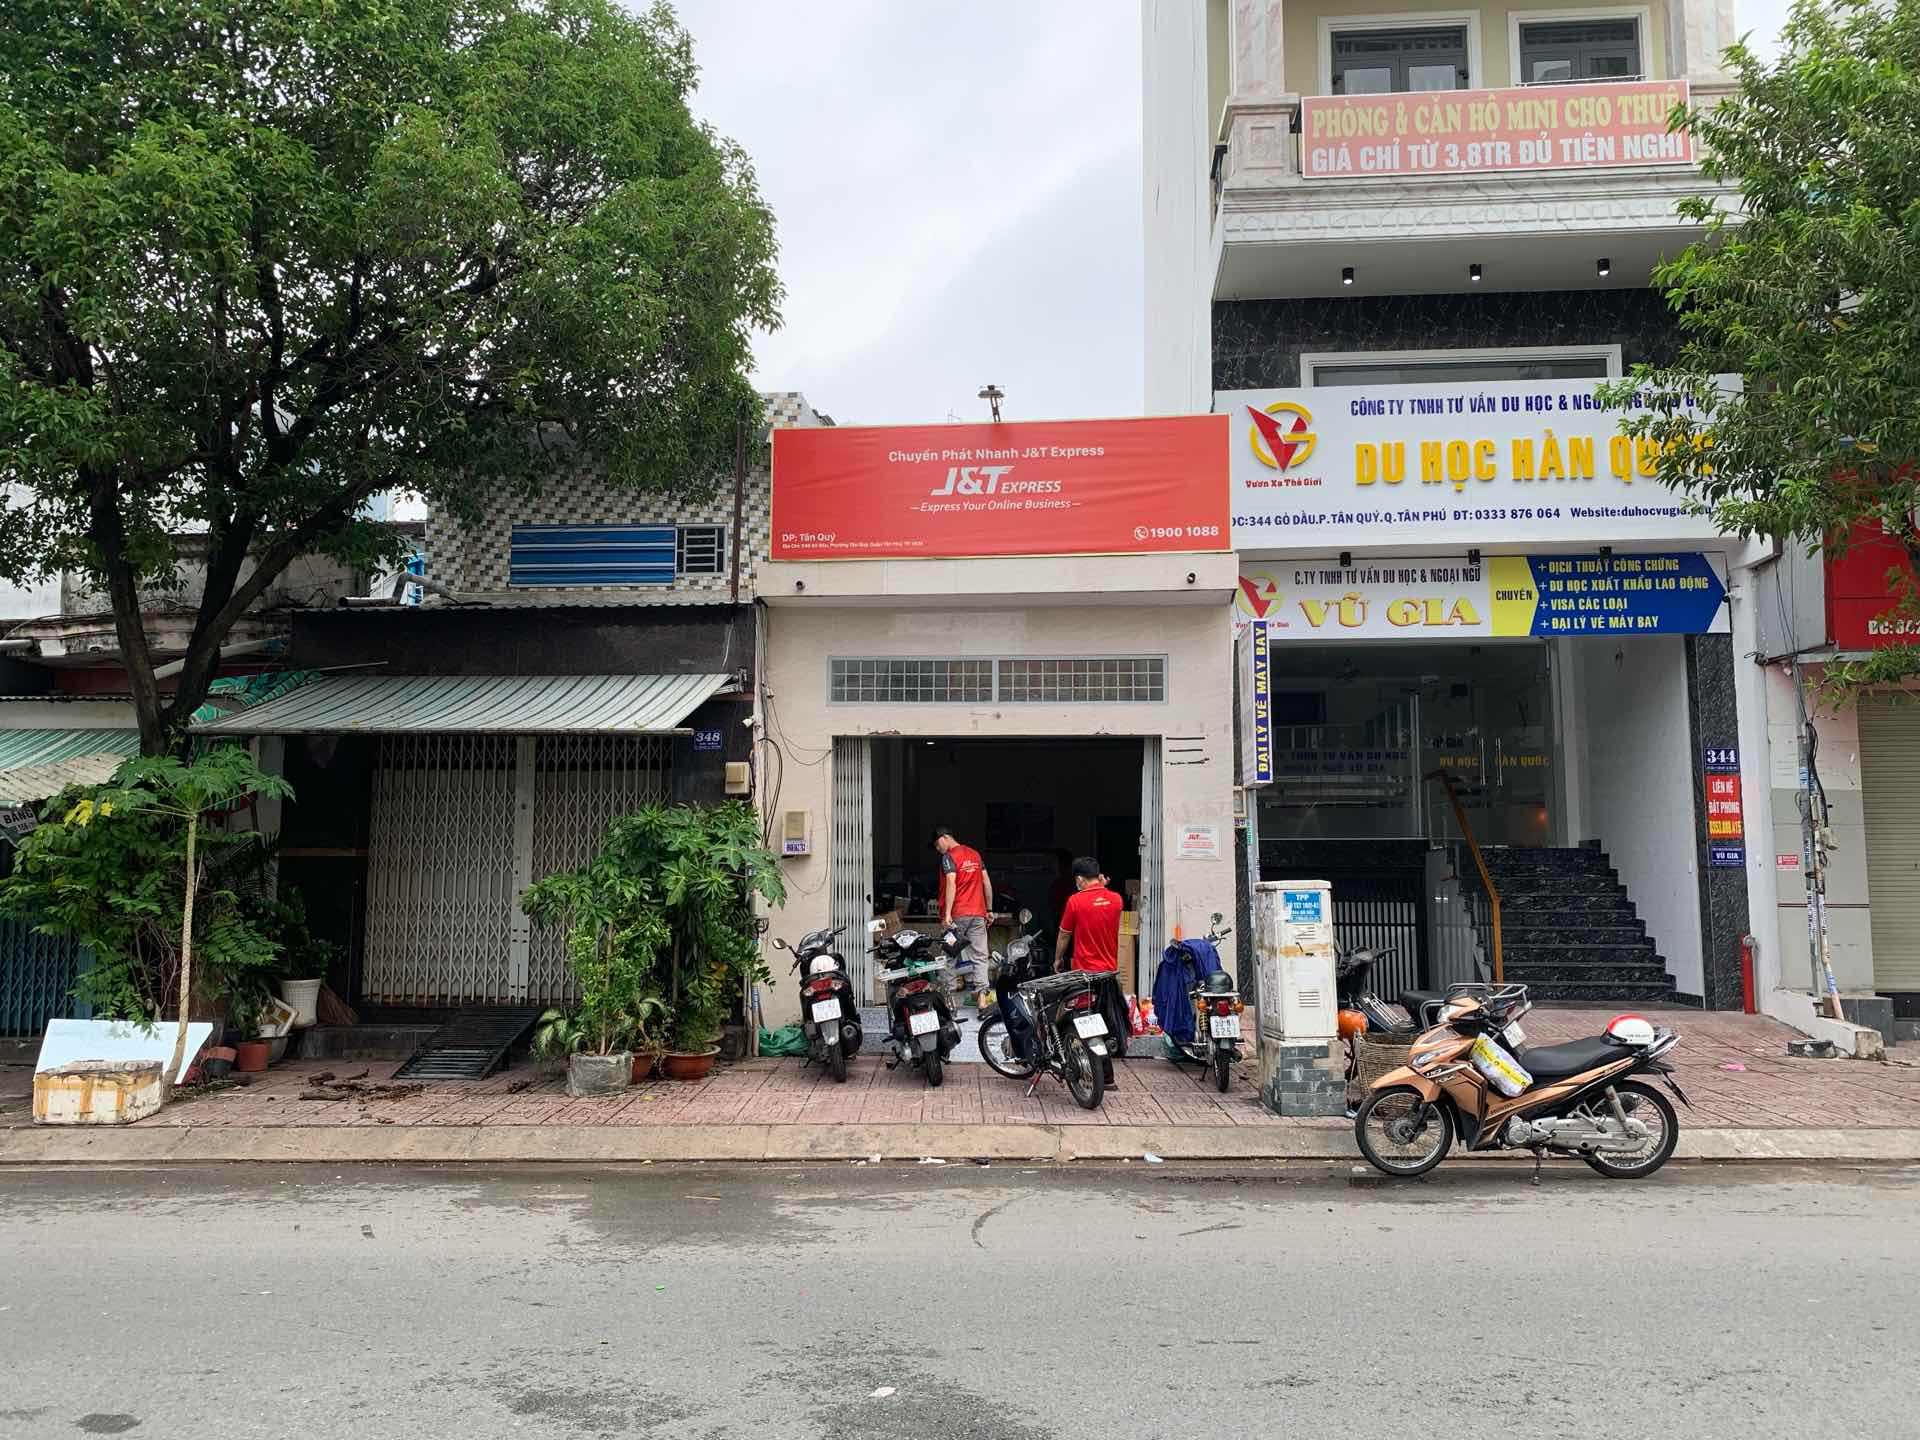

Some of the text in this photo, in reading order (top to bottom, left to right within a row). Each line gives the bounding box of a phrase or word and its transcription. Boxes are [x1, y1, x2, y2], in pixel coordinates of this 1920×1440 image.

[1312, 100, 1390, 138] PHÒNG
[1395, 101, 1409, 135] &
[1415, 95, 1462, 134] CĂN
[1468, 94, 1501, 139] HỘ
[1507, 98, 1558, 130] MINI
[1565, 96, 1611, 128] CHO
[1312, 142, 1352, 172] GIÁ
[1360, 137, 1400, 170] CHỈ
[1407, 140, 1440, 169] TỪ
[1445, 141, 1512, 170] 3,8TR
[1519, 131, 1552, 164] ĐỦ
[1560, 132, 1615, 166] TIỆN
[1351, 396, 1385, 416] CÔNG
[1388, 399, 1405, 415] TY
[1410, 399, 1444, 415] TNHH
[1447, 398, 1465, 414] TƯ
[1470, 392, 1496, 413] VẤN
[1502, 396, 1520, 412] DU
[1525, 395, 1553, 414] HỌC
[1559, 395, 1568, 411] &
[942, 448, 972, 461] Phát
[976, 448, 1019, 460] Nhanh
[1022, 447, 1048, 459] J&T
[1051, 447, 1105, 461] Express
[1355, 441, 1405, 486] DU
[1420, 440, 1497, 492] HỌC
[1511, 428, 1594, 481] HÀN
[930, 465, 1062, 496] J&T EXPRESS
[920, 499, 1071, 515] Express Your Online Business
[1275, 512, 1290, 525] GÒ
[1423, 508, 1447, 521] PHÚ
[1511, 508, 1533, 519] 876
[1537, 507, 1560, 519] 064
[1150, 526, 1219, 538] 1900 1088
[1613, 559, 1641, 572] CÔNG
[1295, 570, 1315, 585] C.TY
[1320, 569, 1342, 585] TNHH
[1344, 569, 1358, 584] TƯ
[1360, 565, 1380, 583] VẤN
[1383, 569, 1396, 583] DU
[1398, 568, 1417, 586] HỌC
[1421, 568, 1427, 583] &
[1430, 568, 1460, 585] NGOẠI
[1550, 580, 1564, 592] DU
[1567, 579, 1588, 593] HỌC
[1655, 577, 1676, 590] LAO
[1496, 589, 1533, 601] CHUYÊN
[1299, 592, 1482, 628] VŨ GIA
[1550, 597, 1628, 611] VISA CÁC LOẠI
[1574, 616, 1586, 629] LÝ
[1609, 614, 1634, 628] MÁY
[1637, 615, 1659, 628] BAY
[1255, 627, 1267, 655] BAY
[695, 732, 720, 742] 348
[1707, 750, 1736, 763] 344
